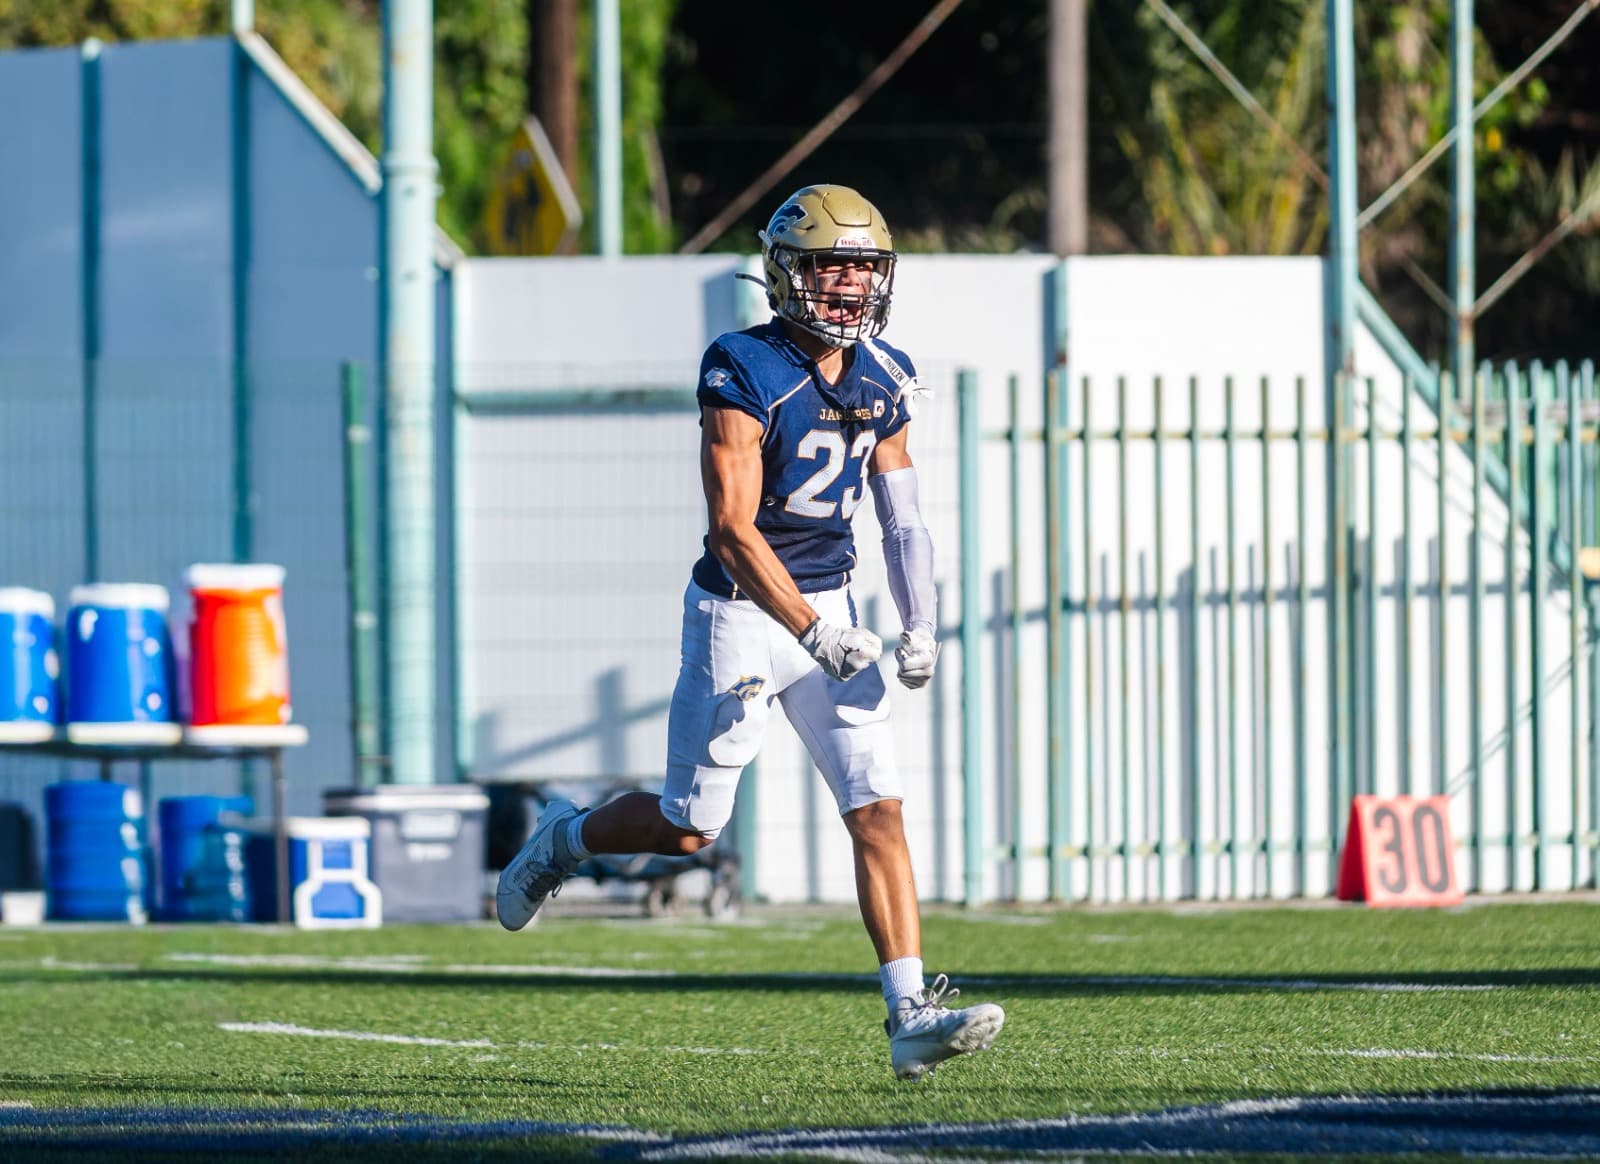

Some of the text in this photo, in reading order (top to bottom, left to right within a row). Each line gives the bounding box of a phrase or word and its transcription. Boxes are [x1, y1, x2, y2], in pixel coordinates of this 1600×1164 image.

[819, 408, 872, 421] JARES
[784, 429, 877, 519] 23
[1373, 804, 1450, 895] 30
